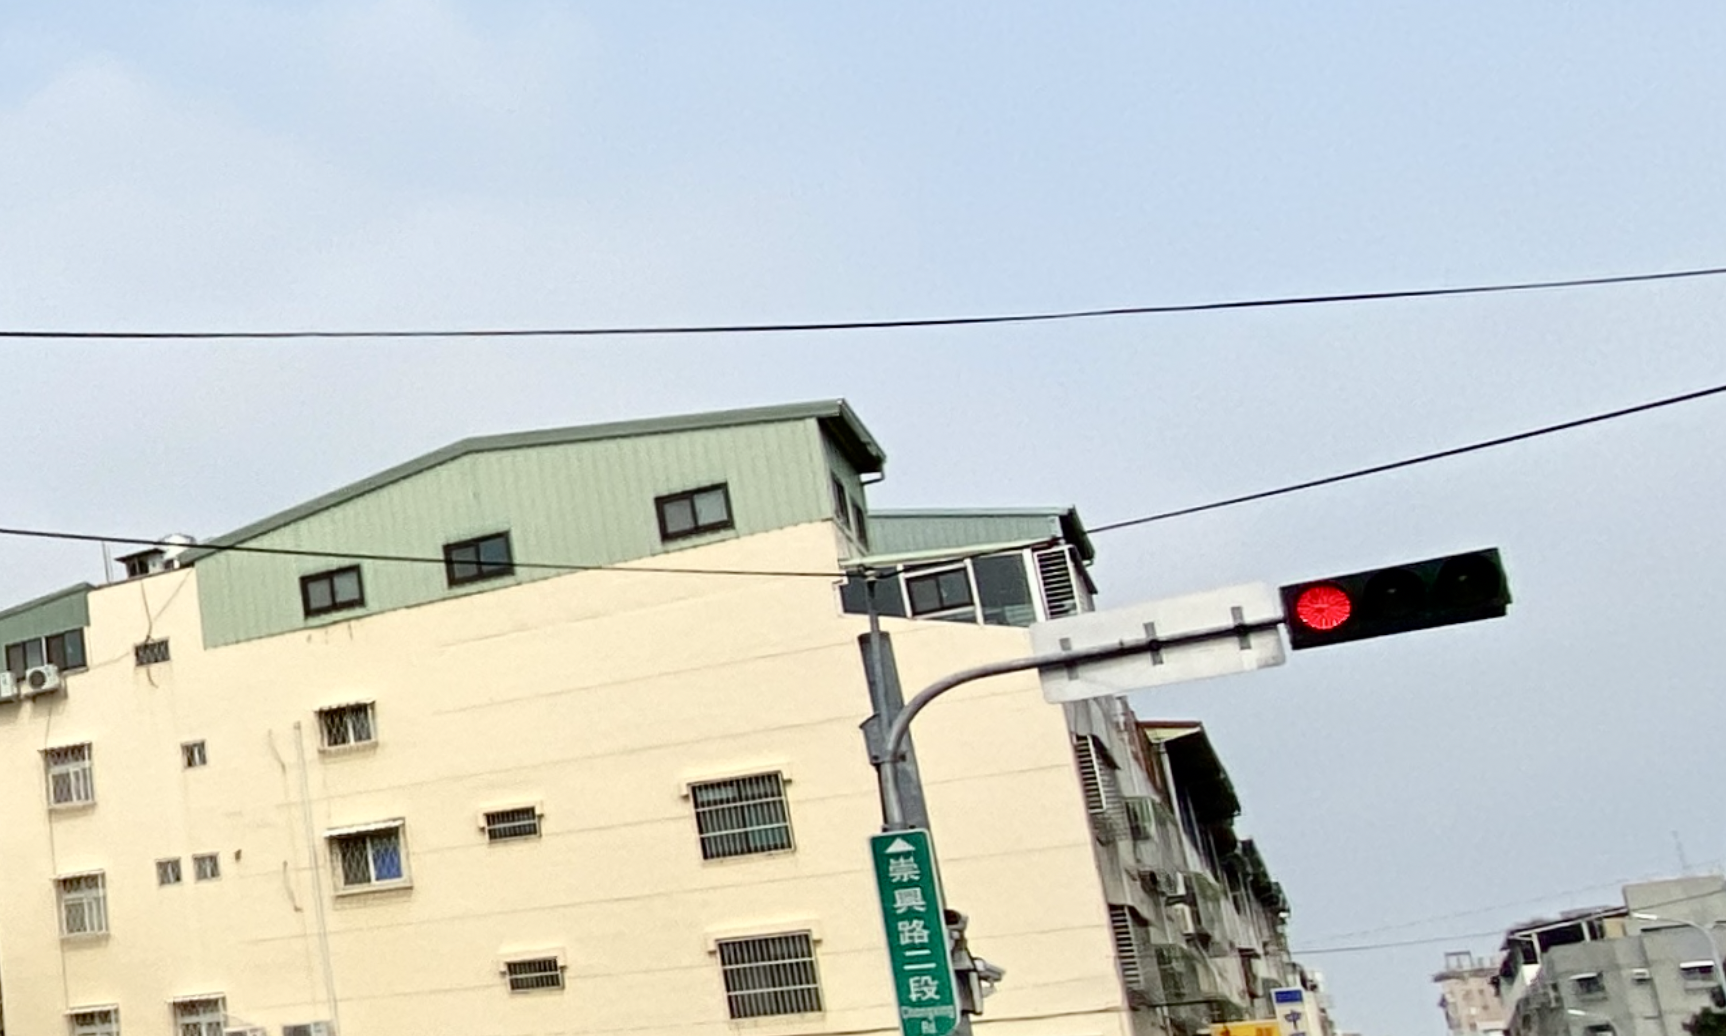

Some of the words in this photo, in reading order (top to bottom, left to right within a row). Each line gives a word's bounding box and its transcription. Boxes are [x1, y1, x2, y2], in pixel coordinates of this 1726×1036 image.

[887, 855, 941, 1002] 崇興路二段
